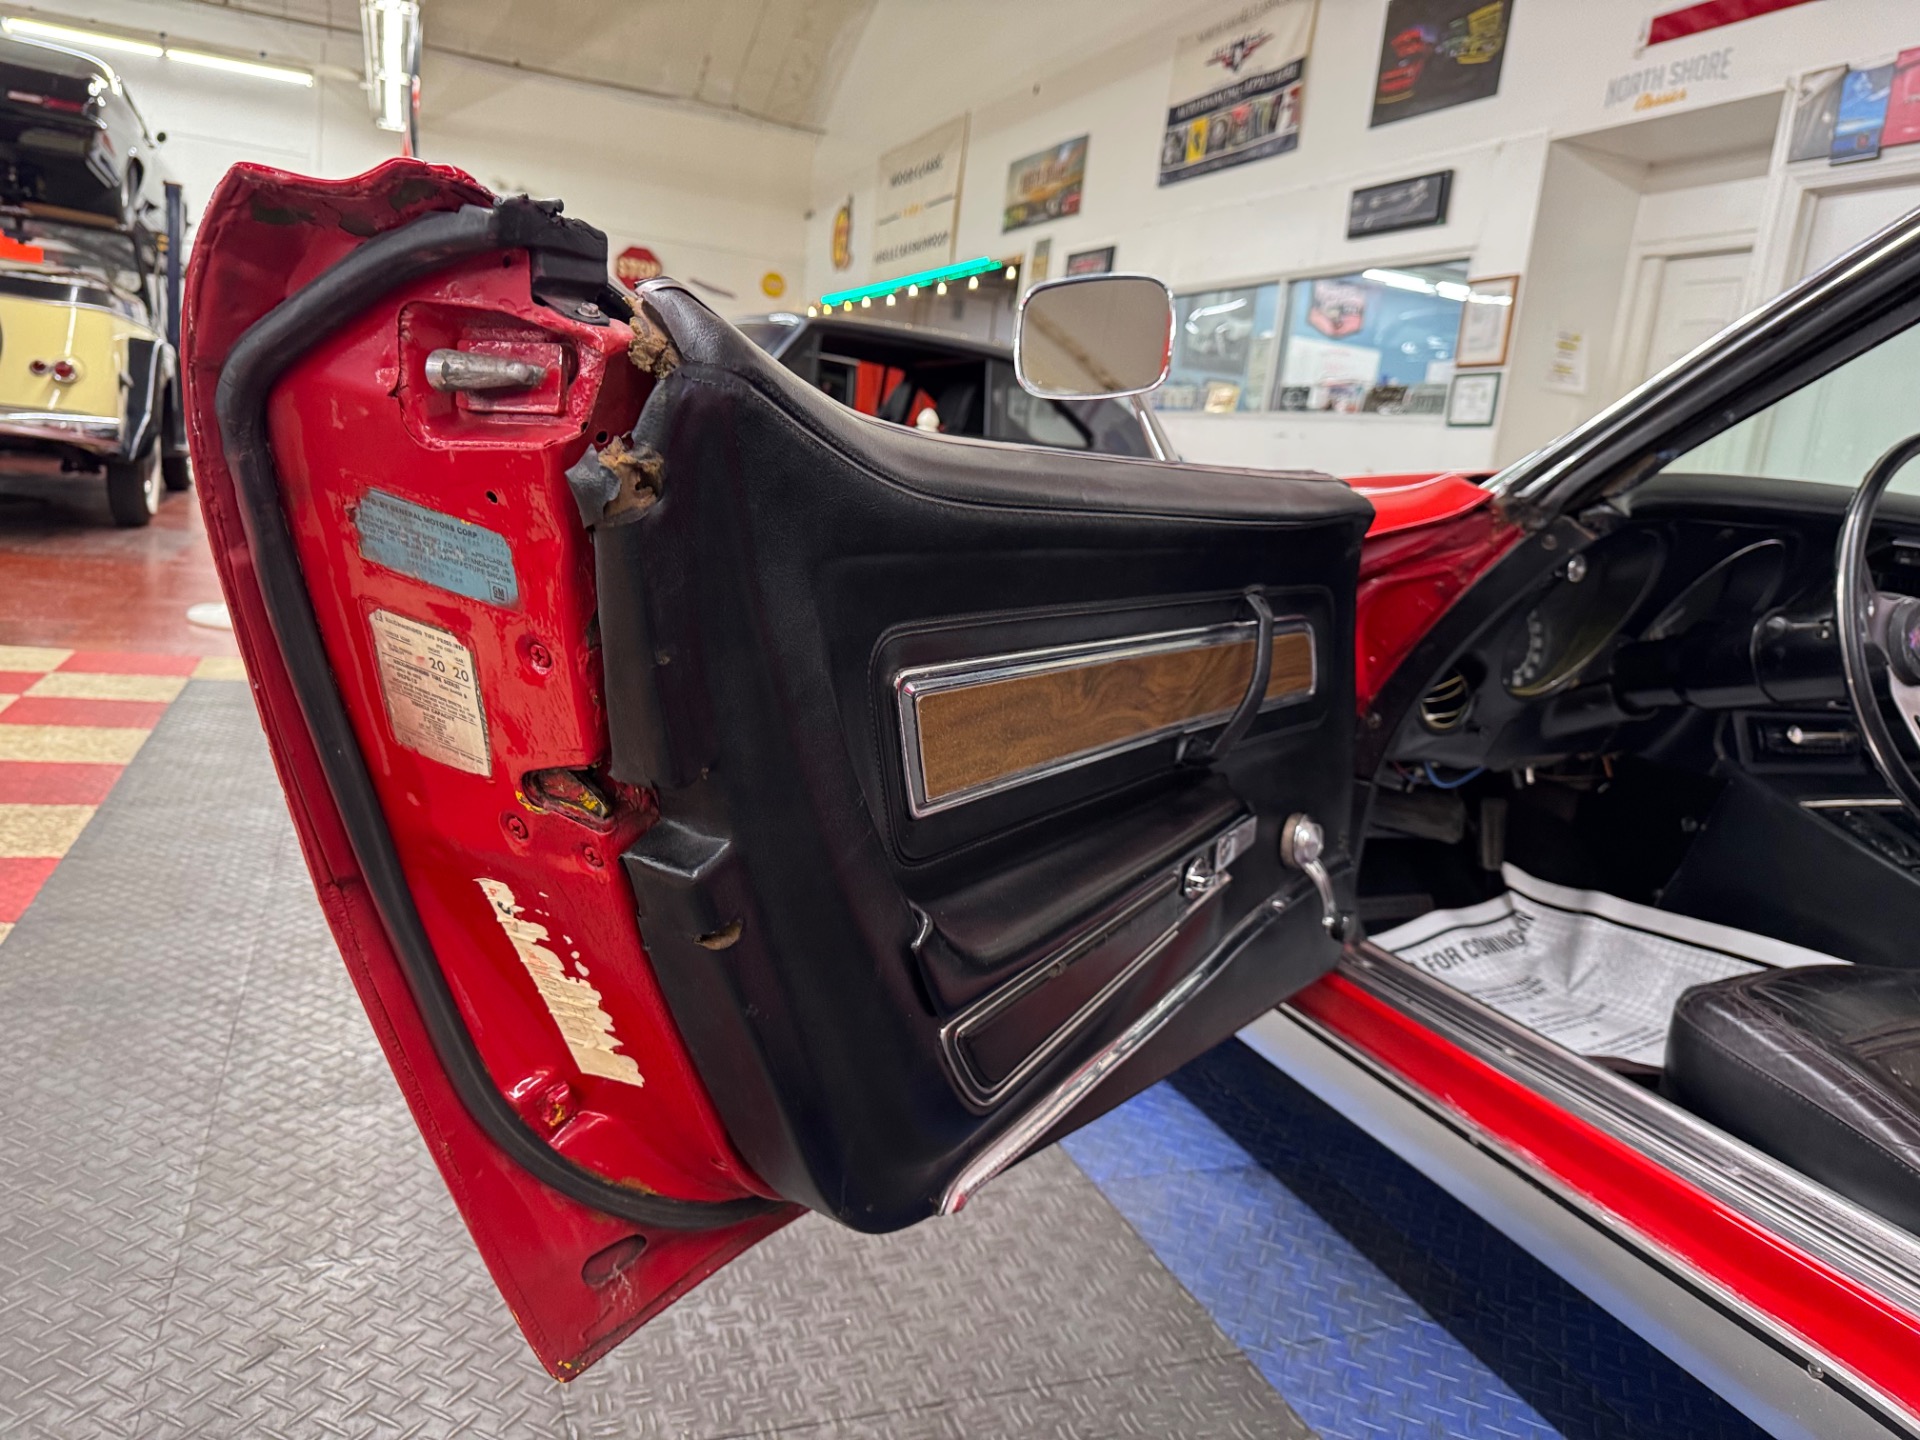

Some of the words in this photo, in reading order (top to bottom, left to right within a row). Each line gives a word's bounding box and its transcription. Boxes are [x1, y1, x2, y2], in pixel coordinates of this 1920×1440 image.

[1604, 66, 1665, 109] NORTH
[1668, 47, 1733, 85] SHORE
[390, 505, 421, 520] GENERAL
[423, 516, 453, 531] MOTORS
[492, 585, 505, 598] GM
[428, 657, 446, 673] 20
[452, 666, 470, 683] 20
[1421, 946, 1465, 973] FOR
